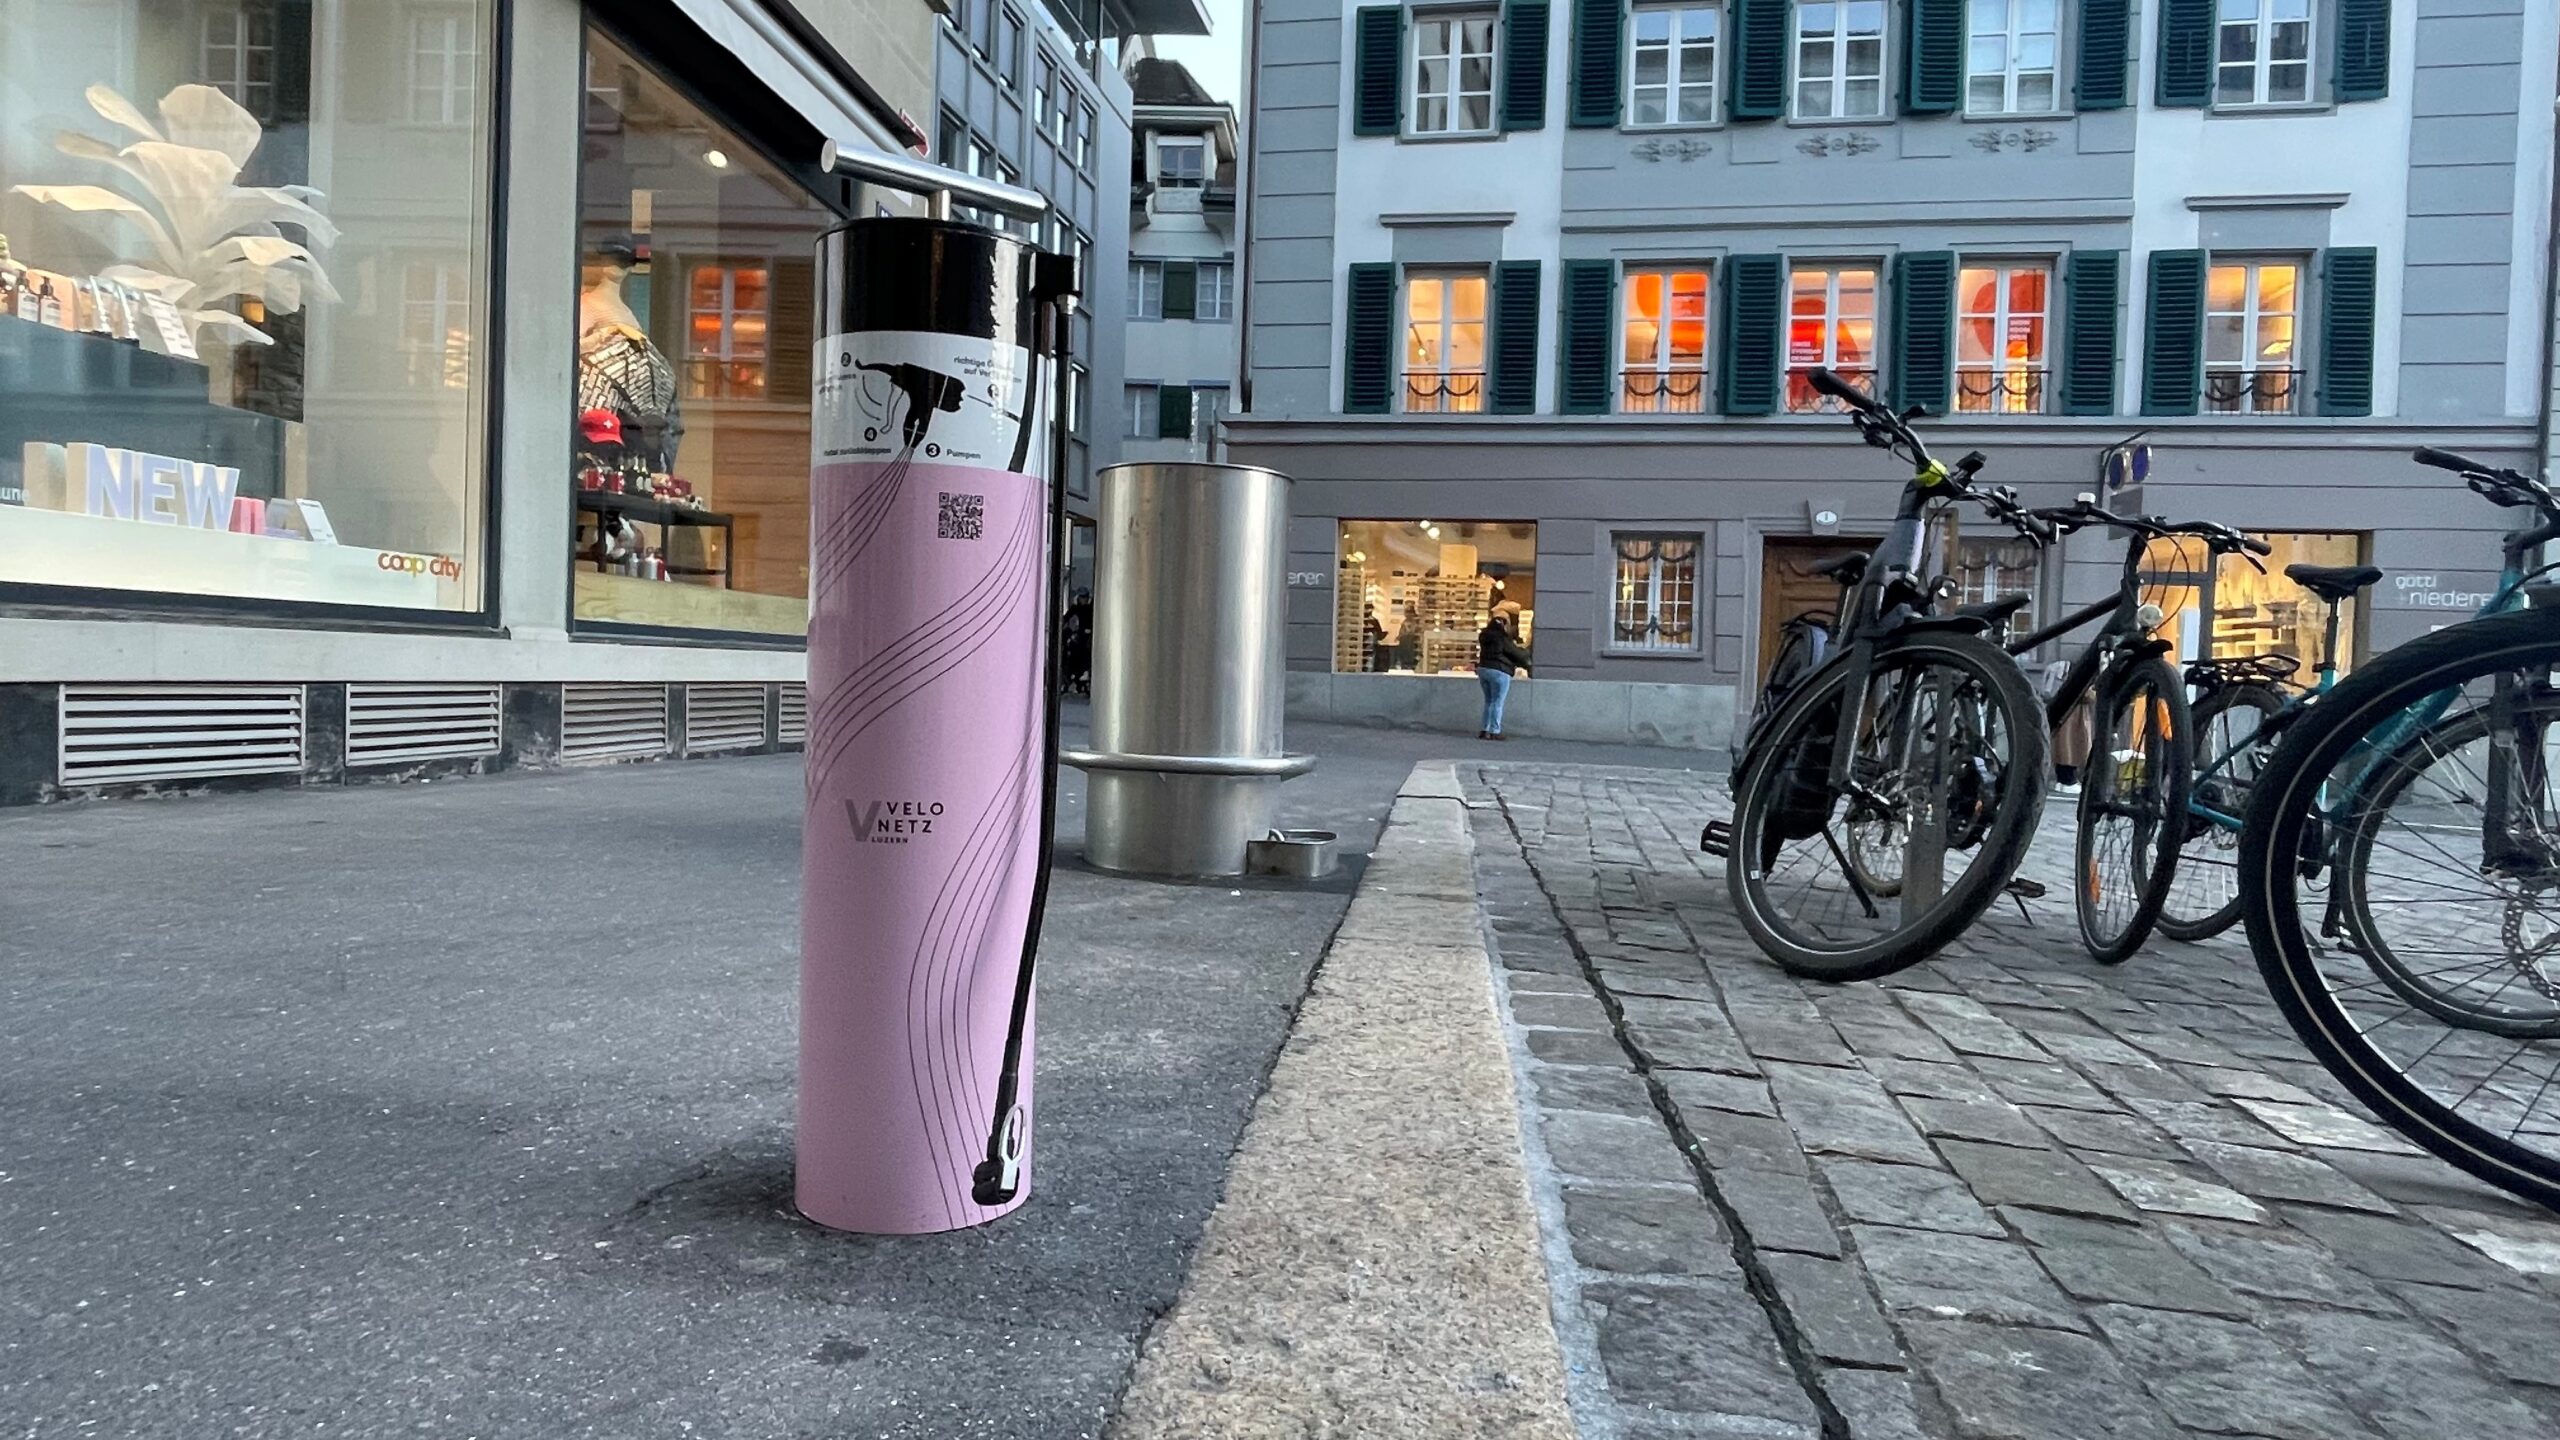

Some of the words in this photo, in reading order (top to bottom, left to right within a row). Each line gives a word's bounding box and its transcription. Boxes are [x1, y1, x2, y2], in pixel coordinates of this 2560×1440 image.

[946, 448, 982, 460] Pumpen
[86, 443, 241, 534] NEW
[378, 552, 427, 579] coop
[429, 554, 463, 583] city
[1287, 571, 1326, 586] erer
[2409, 588, 2495, 608] niedere
[886, 801, 944, 816] VELO
[877, 819, 933, 834] NETZ
[871, 836, 909, 844] LUZERN
